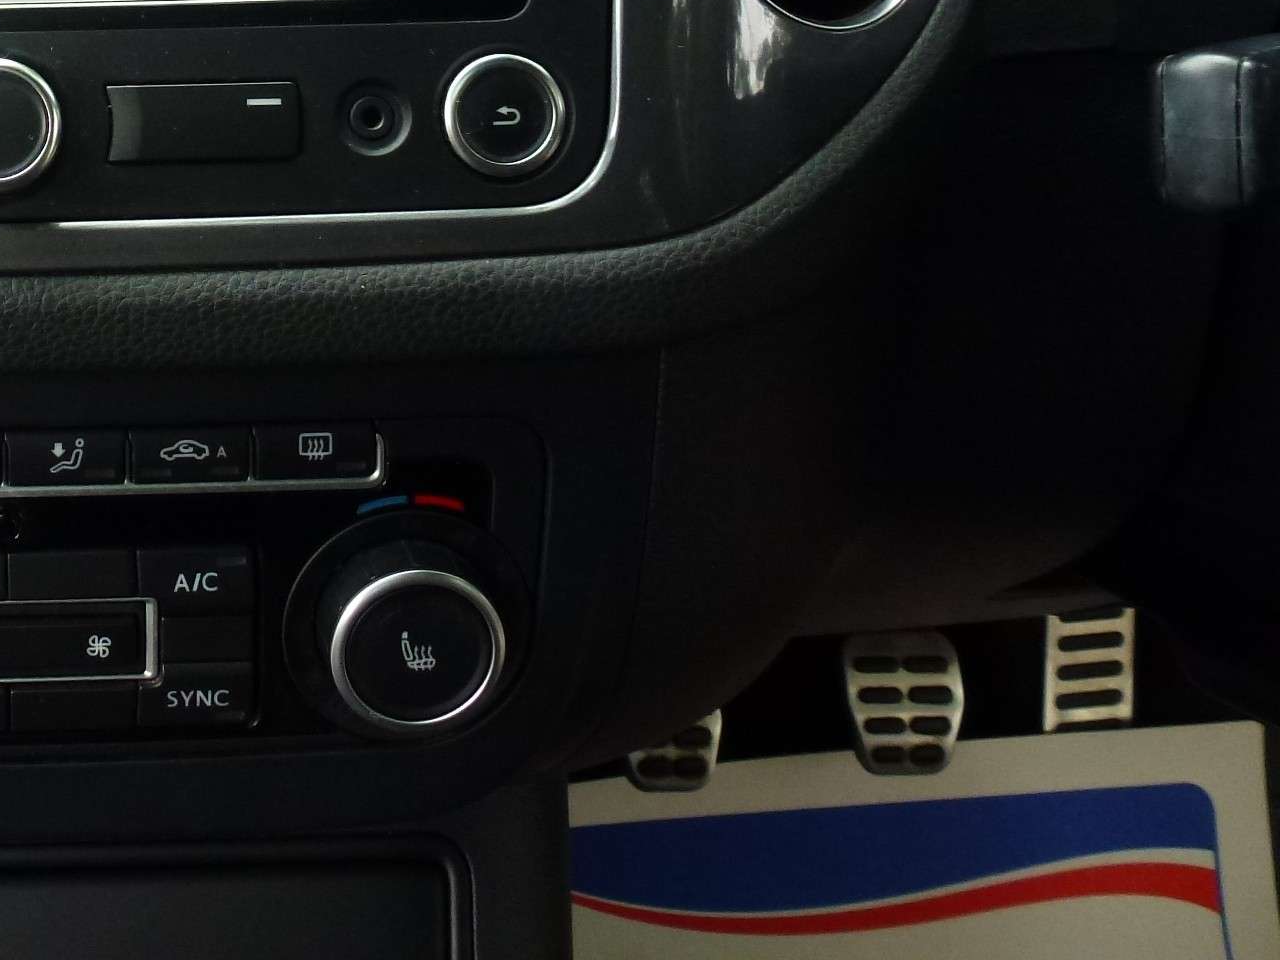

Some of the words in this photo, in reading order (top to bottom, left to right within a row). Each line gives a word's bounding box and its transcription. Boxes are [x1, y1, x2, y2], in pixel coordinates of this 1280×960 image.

[216, 445, 227, 458] A
[173, 572, 219, 593] A/C
[167, 689, 230, 708] SYNC
